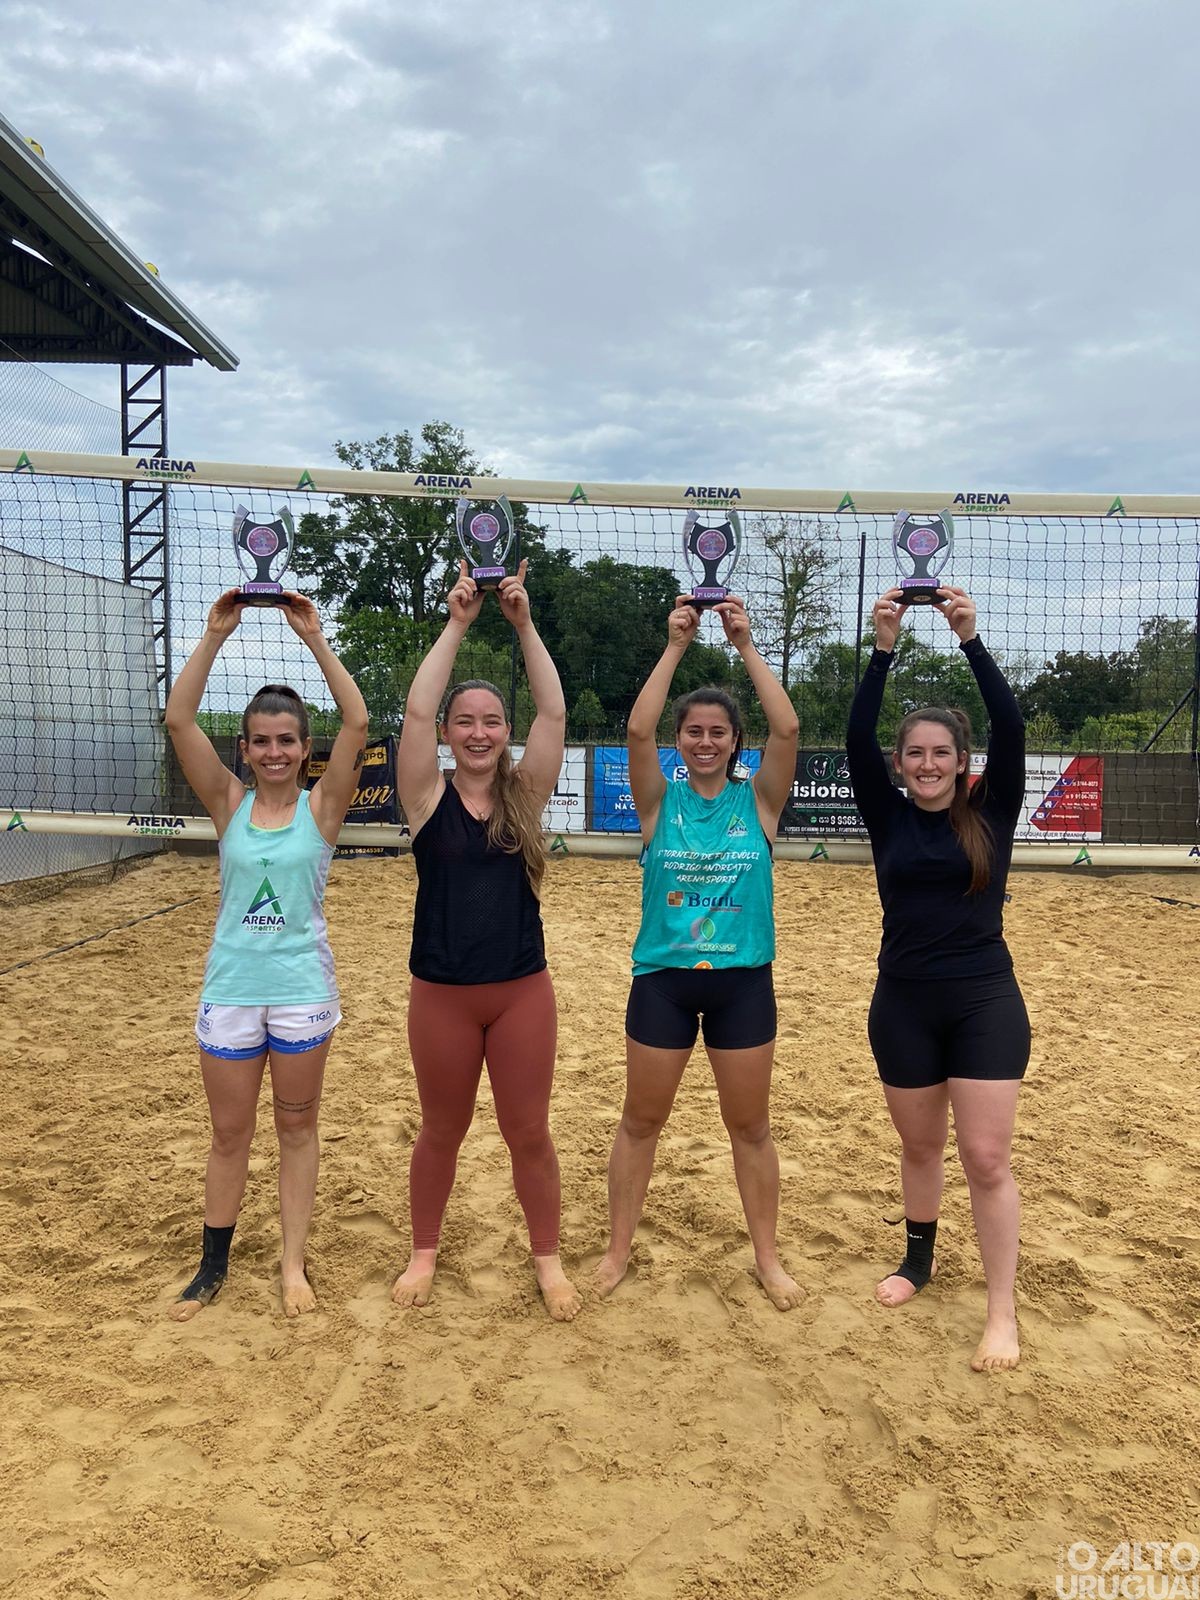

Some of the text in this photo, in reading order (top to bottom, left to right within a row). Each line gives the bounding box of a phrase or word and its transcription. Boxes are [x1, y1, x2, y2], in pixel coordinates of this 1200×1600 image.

[136, 458, 196, 473] ARENA
[149, 471, 186, 480] SPORTS
[414, 475, 472, 489] ARENA
[427, 488, 461, 496] SPORTS
[684, 486, 741, 499] ARENA
[697, 499, 730, 507] SPORTS
[953, 493, 1011, 505] ARENA
[127, 816, 186, 828] ARENA
[140, 827, 173, 836] SPORTS
[664, 849, 700, 860] TORNEIO
[664, 861, 753, 872] RODRIGO ANDREATTO
[241, 915, 286, 926] ARENA
